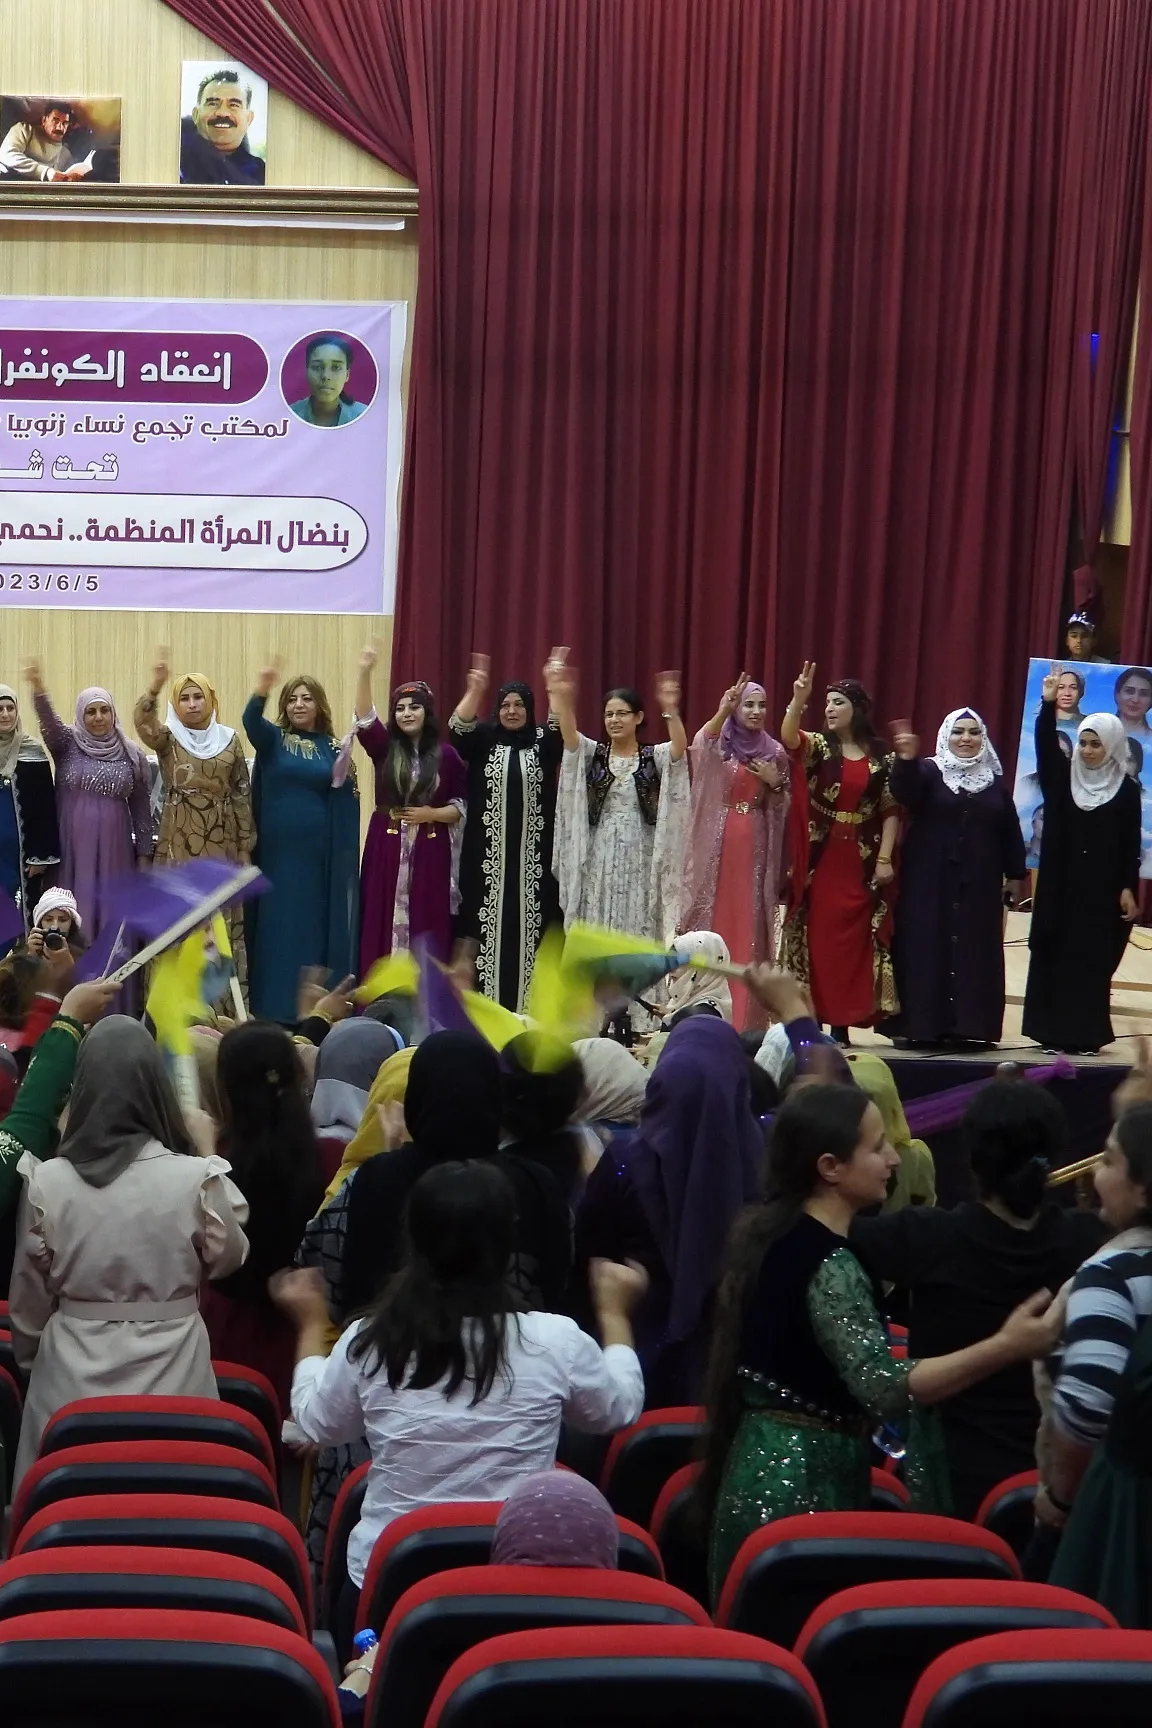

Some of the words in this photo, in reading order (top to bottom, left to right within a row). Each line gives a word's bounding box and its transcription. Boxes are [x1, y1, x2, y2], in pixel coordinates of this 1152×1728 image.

[140, 350, 231, 390] انعقاد
[7, 412, 65, 437] زنوبيا
[73, 414, 125, 433] نساء
[132, 415, 194, 443] تجمع
[200, 416, 289, 442] لمكتب
[51, 453, 119, 481] تحت
[200, 515, 271, 552] المرأة
[277, 520, 349, 553] بنضال
